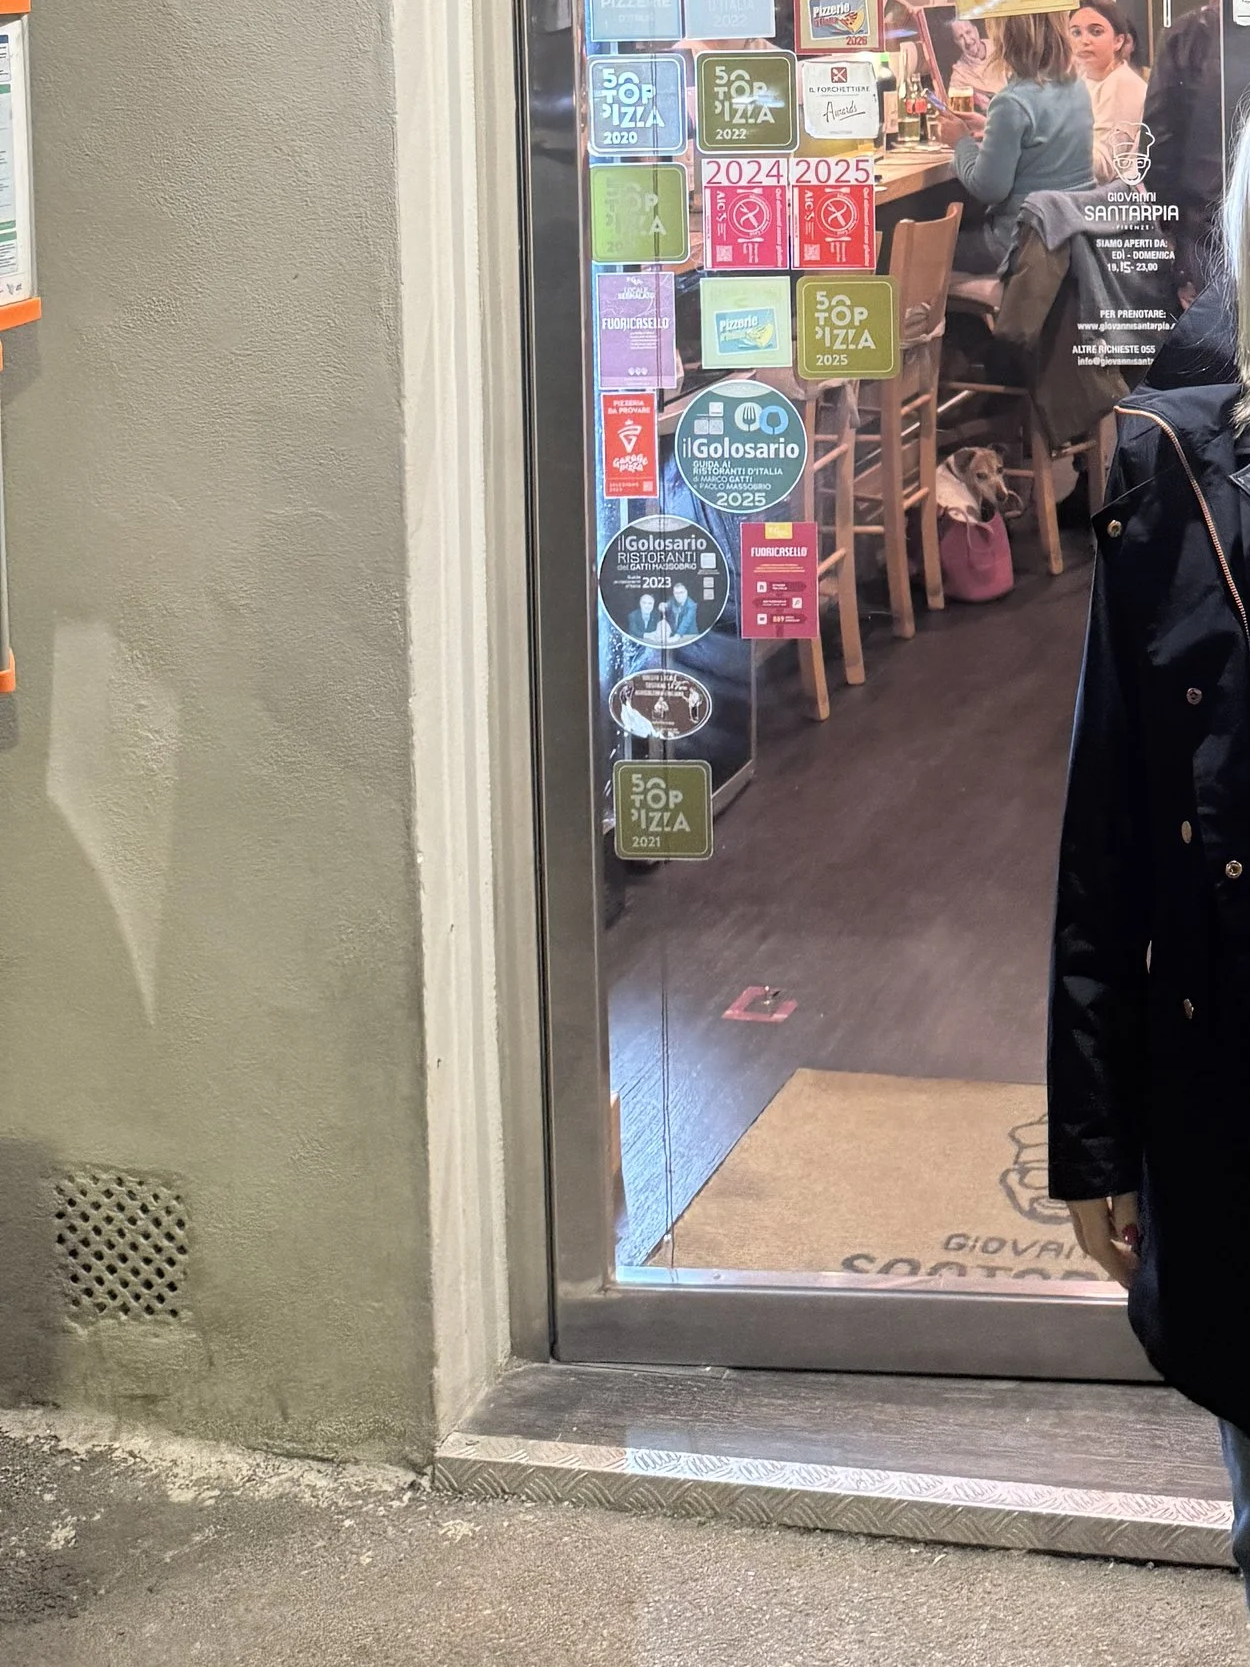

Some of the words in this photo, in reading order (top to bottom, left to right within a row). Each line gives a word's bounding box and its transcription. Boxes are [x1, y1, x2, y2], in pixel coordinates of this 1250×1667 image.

[813, 1, 850, 18] Pizzerie
[601, 83, 656, 105] TOP
[603, 131, 638, 145] 2020
[716, 129, 747, 140] 2022
[706, 159, 784, 185] 2024
[795, 159, 870, 184] 2025
[1107, 192, 1157, 202] GIOVANNI
[1084, 205, 1179, 222] SANTARPIA
[1096, 238, 1123, 248] SIAMO
[1124, 238, 1153, 248] APERTI
[1154, 238, 1168, 248] DA:
[1133, 251, 1175, 260] DOMENICA
[1136, 262, 1158, 272] 23,00
[815, 305, 869, 326] TOP
[1099, 309, 1116, 319] PER
[1117, 309, 1167, 319] PRENOTARE:
[601, 317, 670, 331] FUORICASELLO
[1072, 344, 1097, 354] ALTRE
[1098, 344, 1140, 354] RICHIESTE
[1141, 344, 1156, 354] 055
[816, 354, 848, 366] 2025
[692, 460, 720, 469] GUIDA
[722, 460, 731, 469] AI
[692, 467, 746, 476] RISTORANTI
[747, 467, 784, 476] D'ITALIA
[700, 475, 728, 484] MARCO
[729, 475, 753, 484] GATTI
[700, 483, 725, 491] PAOLO
[726, 483, 772, 491] MASSOBRIO
[716, 492, 767, 507] 2025
[617, 551, 697, 564] RISTORANTI
[751, 546, 808, 557] FUORICASELLO
[630, 563, 652, 571] GATTI
[652, 562, 697, 571] MASSOBRIO
[642, 576, 672, 589] 2023
[630, 788, 684, 810] TOP
[632, 835, 661, 848] 2021
